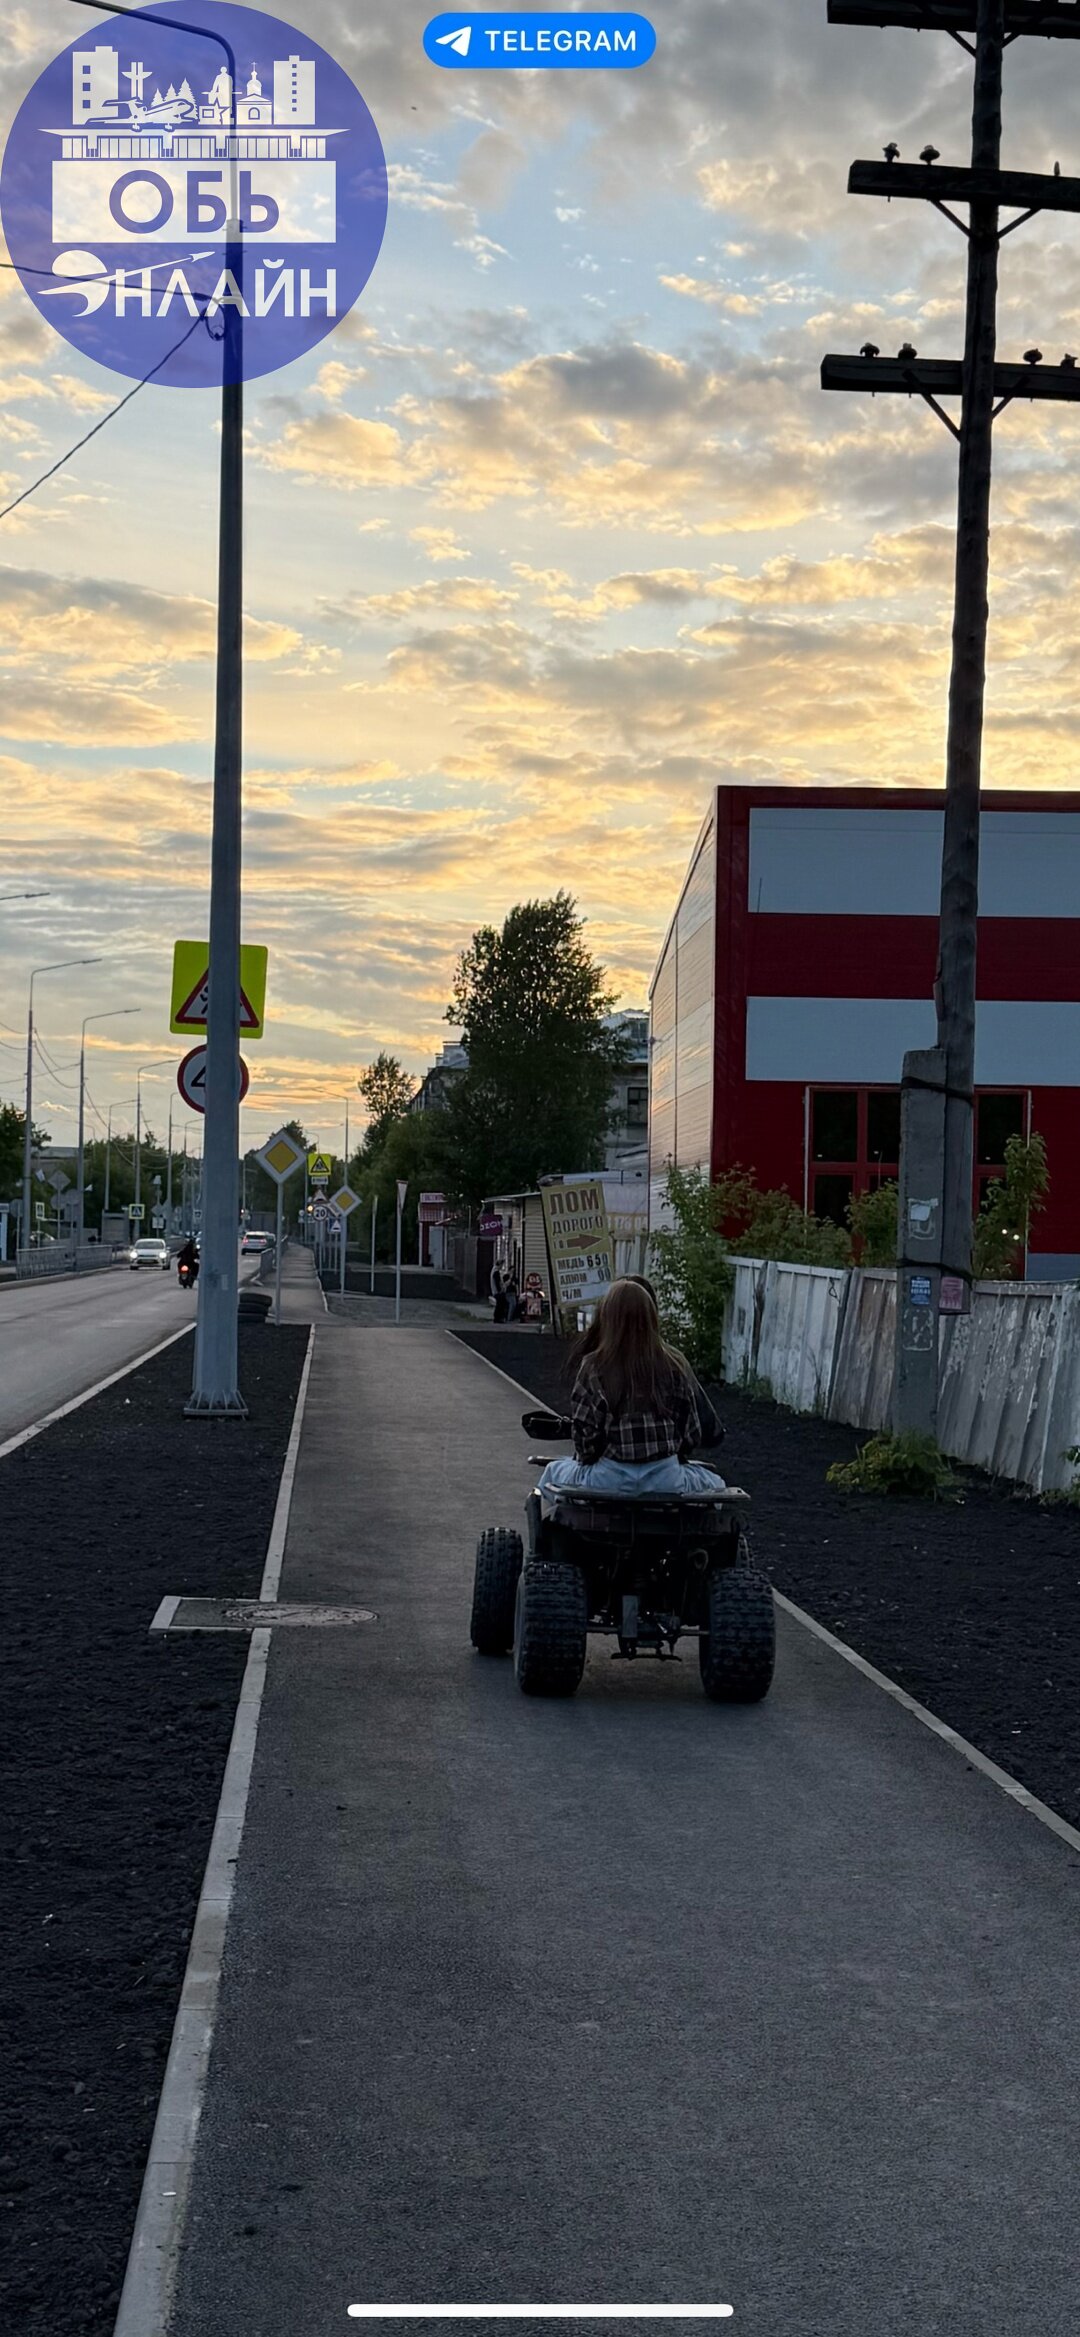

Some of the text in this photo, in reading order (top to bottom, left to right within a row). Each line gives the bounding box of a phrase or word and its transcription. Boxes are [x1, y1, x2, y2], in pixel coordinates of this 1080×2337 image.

[550, 1188, 599, 1216] ЛОМ
[315, 1209, 325, 1218] 20
[552, 1215, 603, 1236] ДОРОГО
[557, 1257, 585, 1270] МЕДЬ
